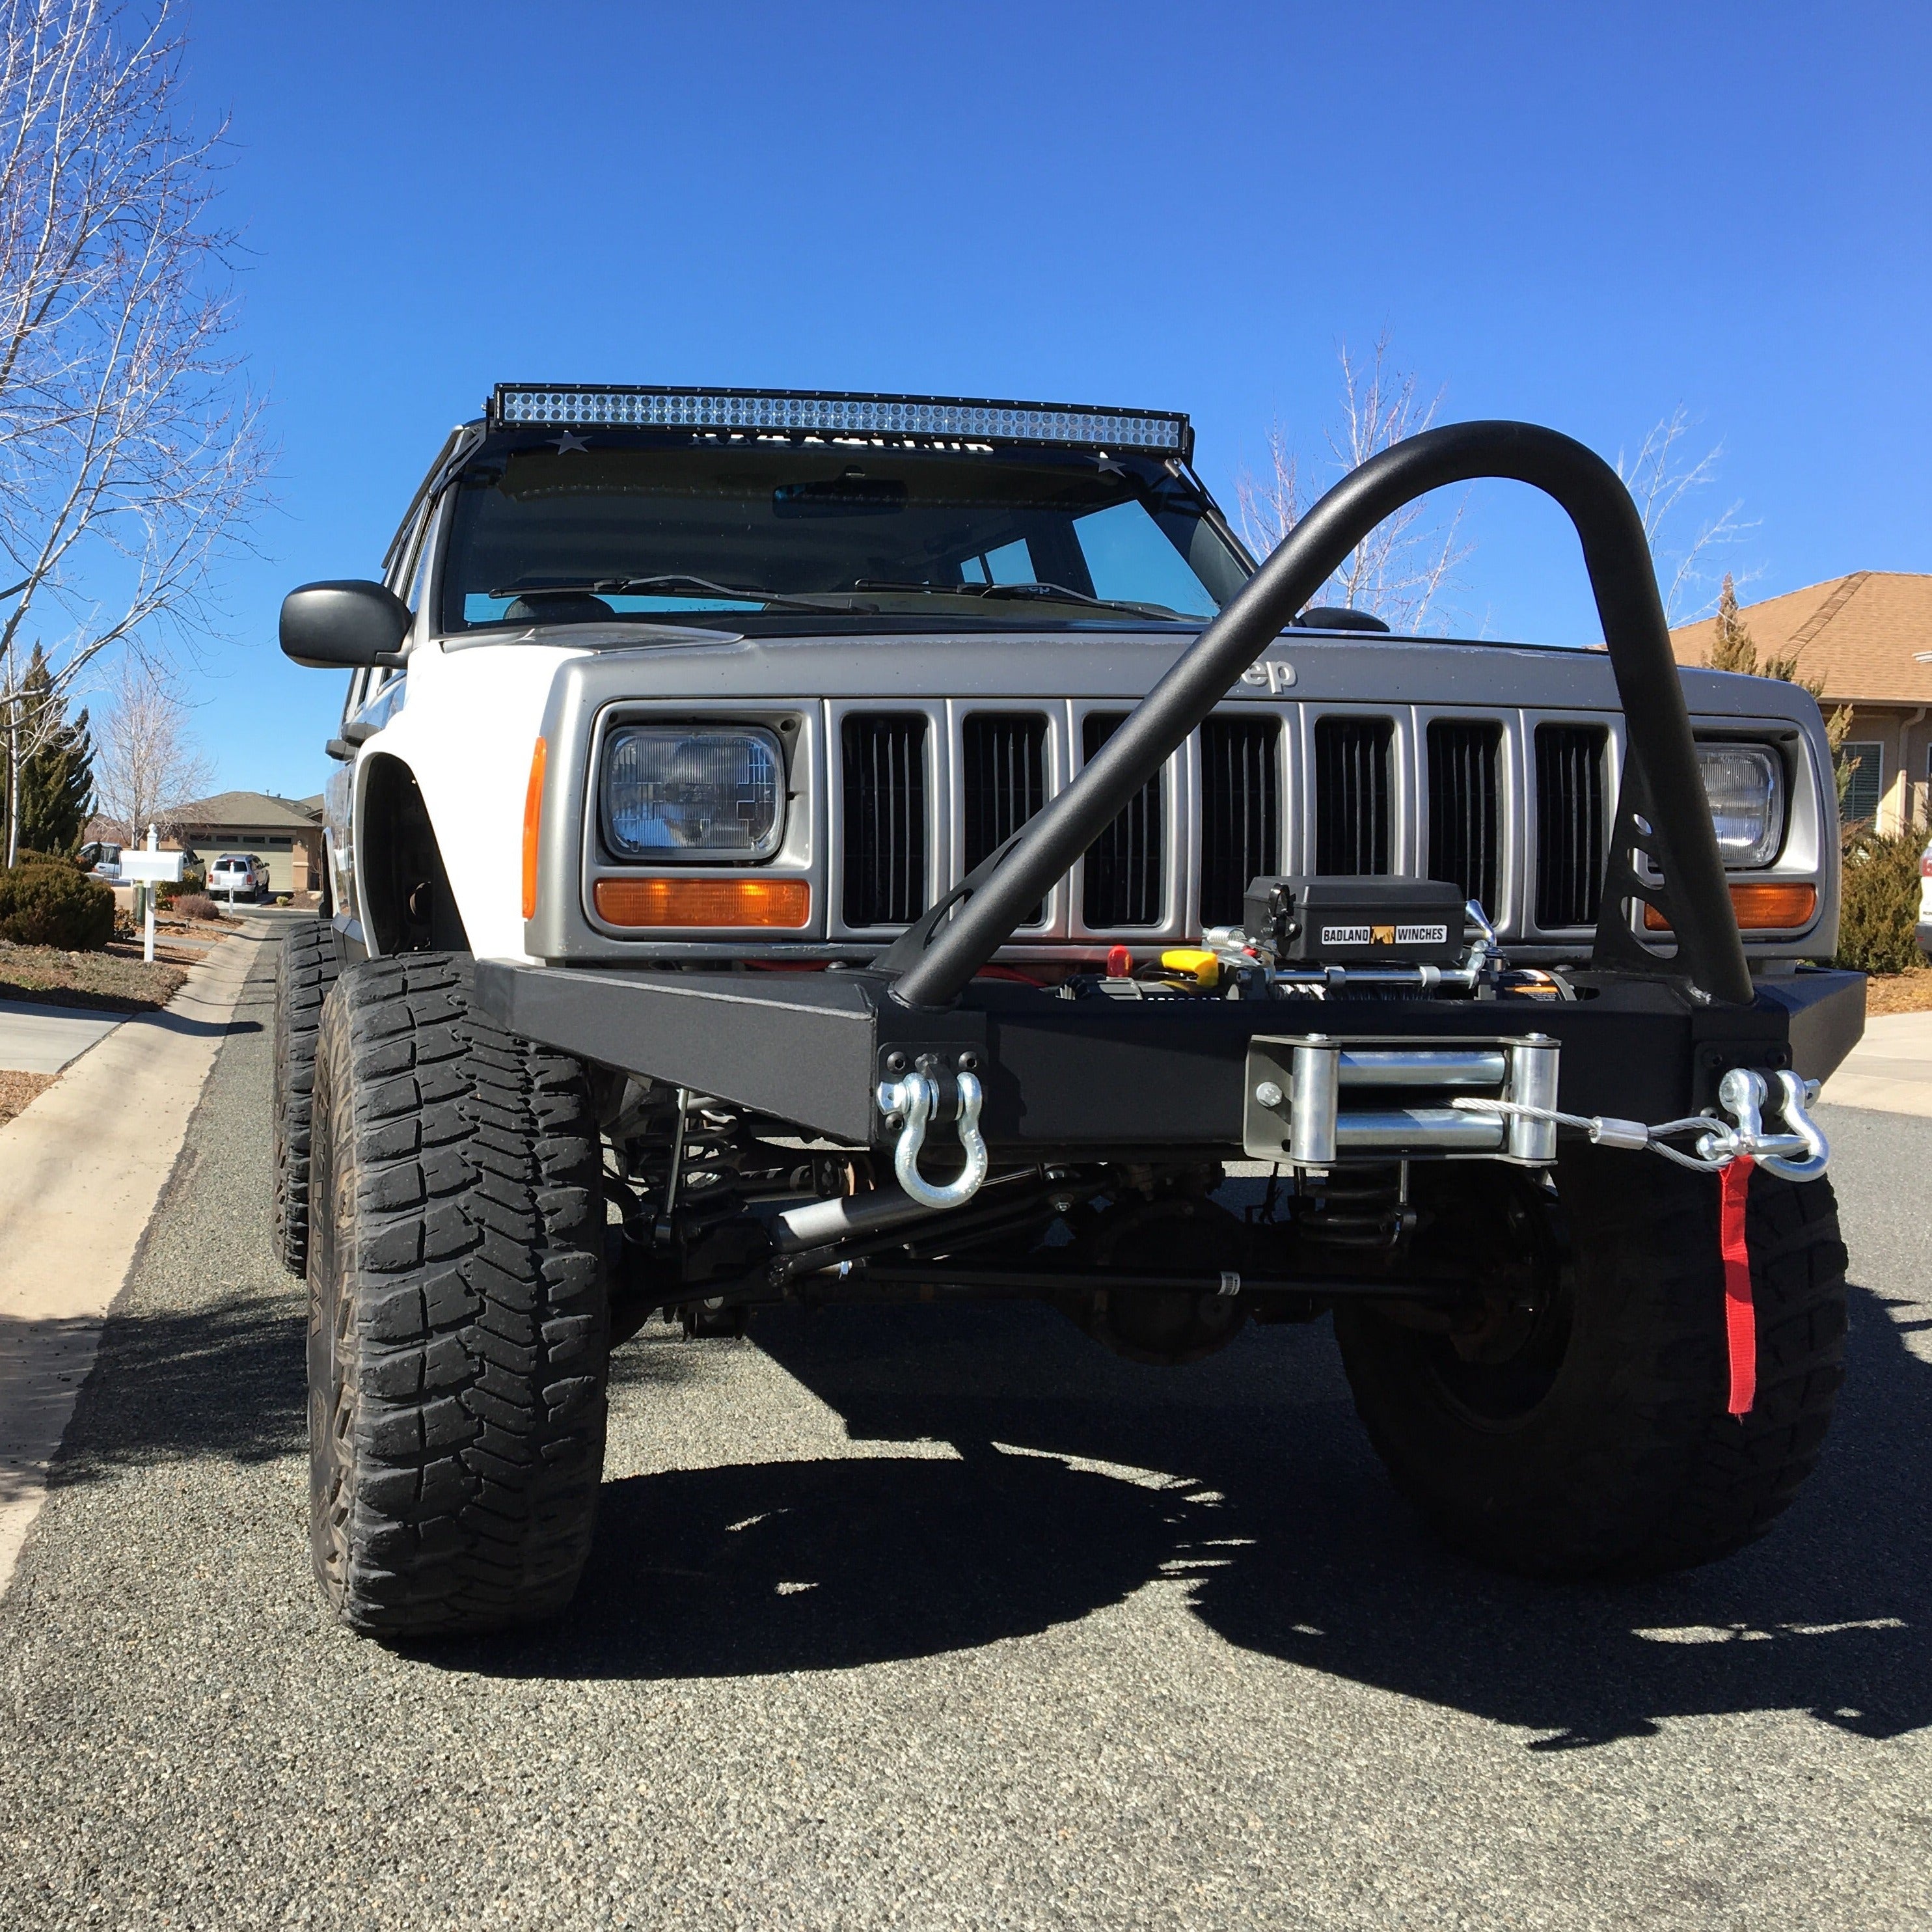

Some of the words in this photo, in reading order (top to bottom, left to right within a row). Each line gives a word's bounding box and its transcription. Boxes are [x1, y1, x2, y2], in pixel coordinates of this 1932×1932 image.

[1241, 660, 1298, 694] ep
[1324, 929, 1368, 942] BADLAND
[1398, 928, 1443, 940] WINCHES
